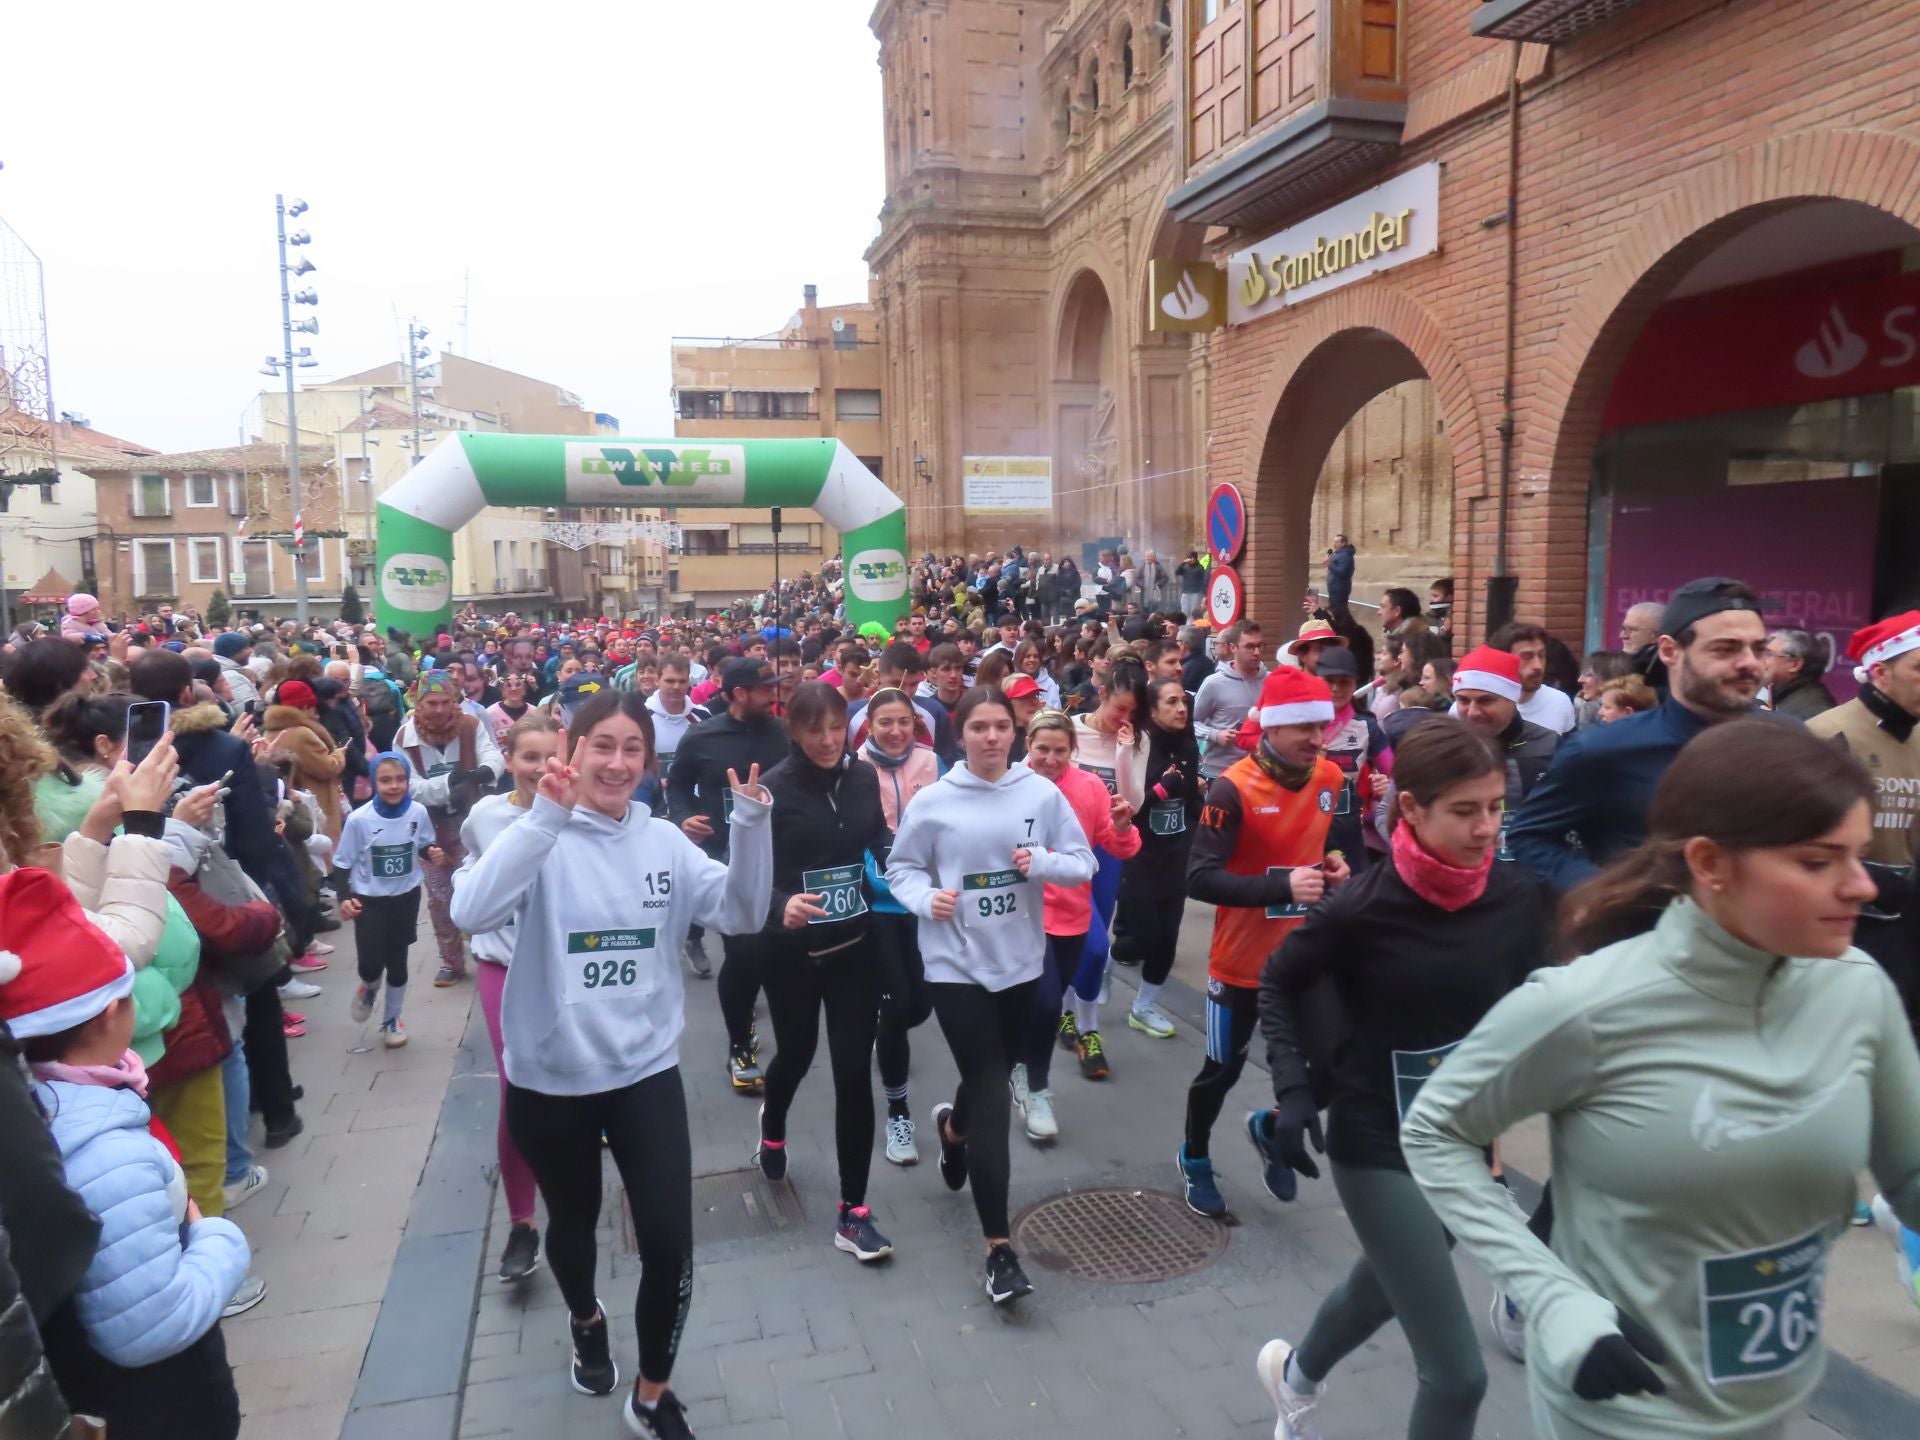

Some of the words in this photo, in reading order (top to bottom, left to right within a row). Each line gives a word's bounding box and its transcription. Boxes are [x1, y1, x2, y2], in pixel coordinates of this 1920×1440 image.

[1269, 208, 1412, 297] Santander
[588, 459, 724, 473] TWINNER
[1024, 818, 1035, 838] 7
[1163, 812, 1178, 829] 78
[384, 857, 404, 874] 63
[645, 870, 671, 896] 15
[818, 886, 856, 914] 260
[978, 892, 1017, 918] 932
[583, 959, 637, 989] 926
